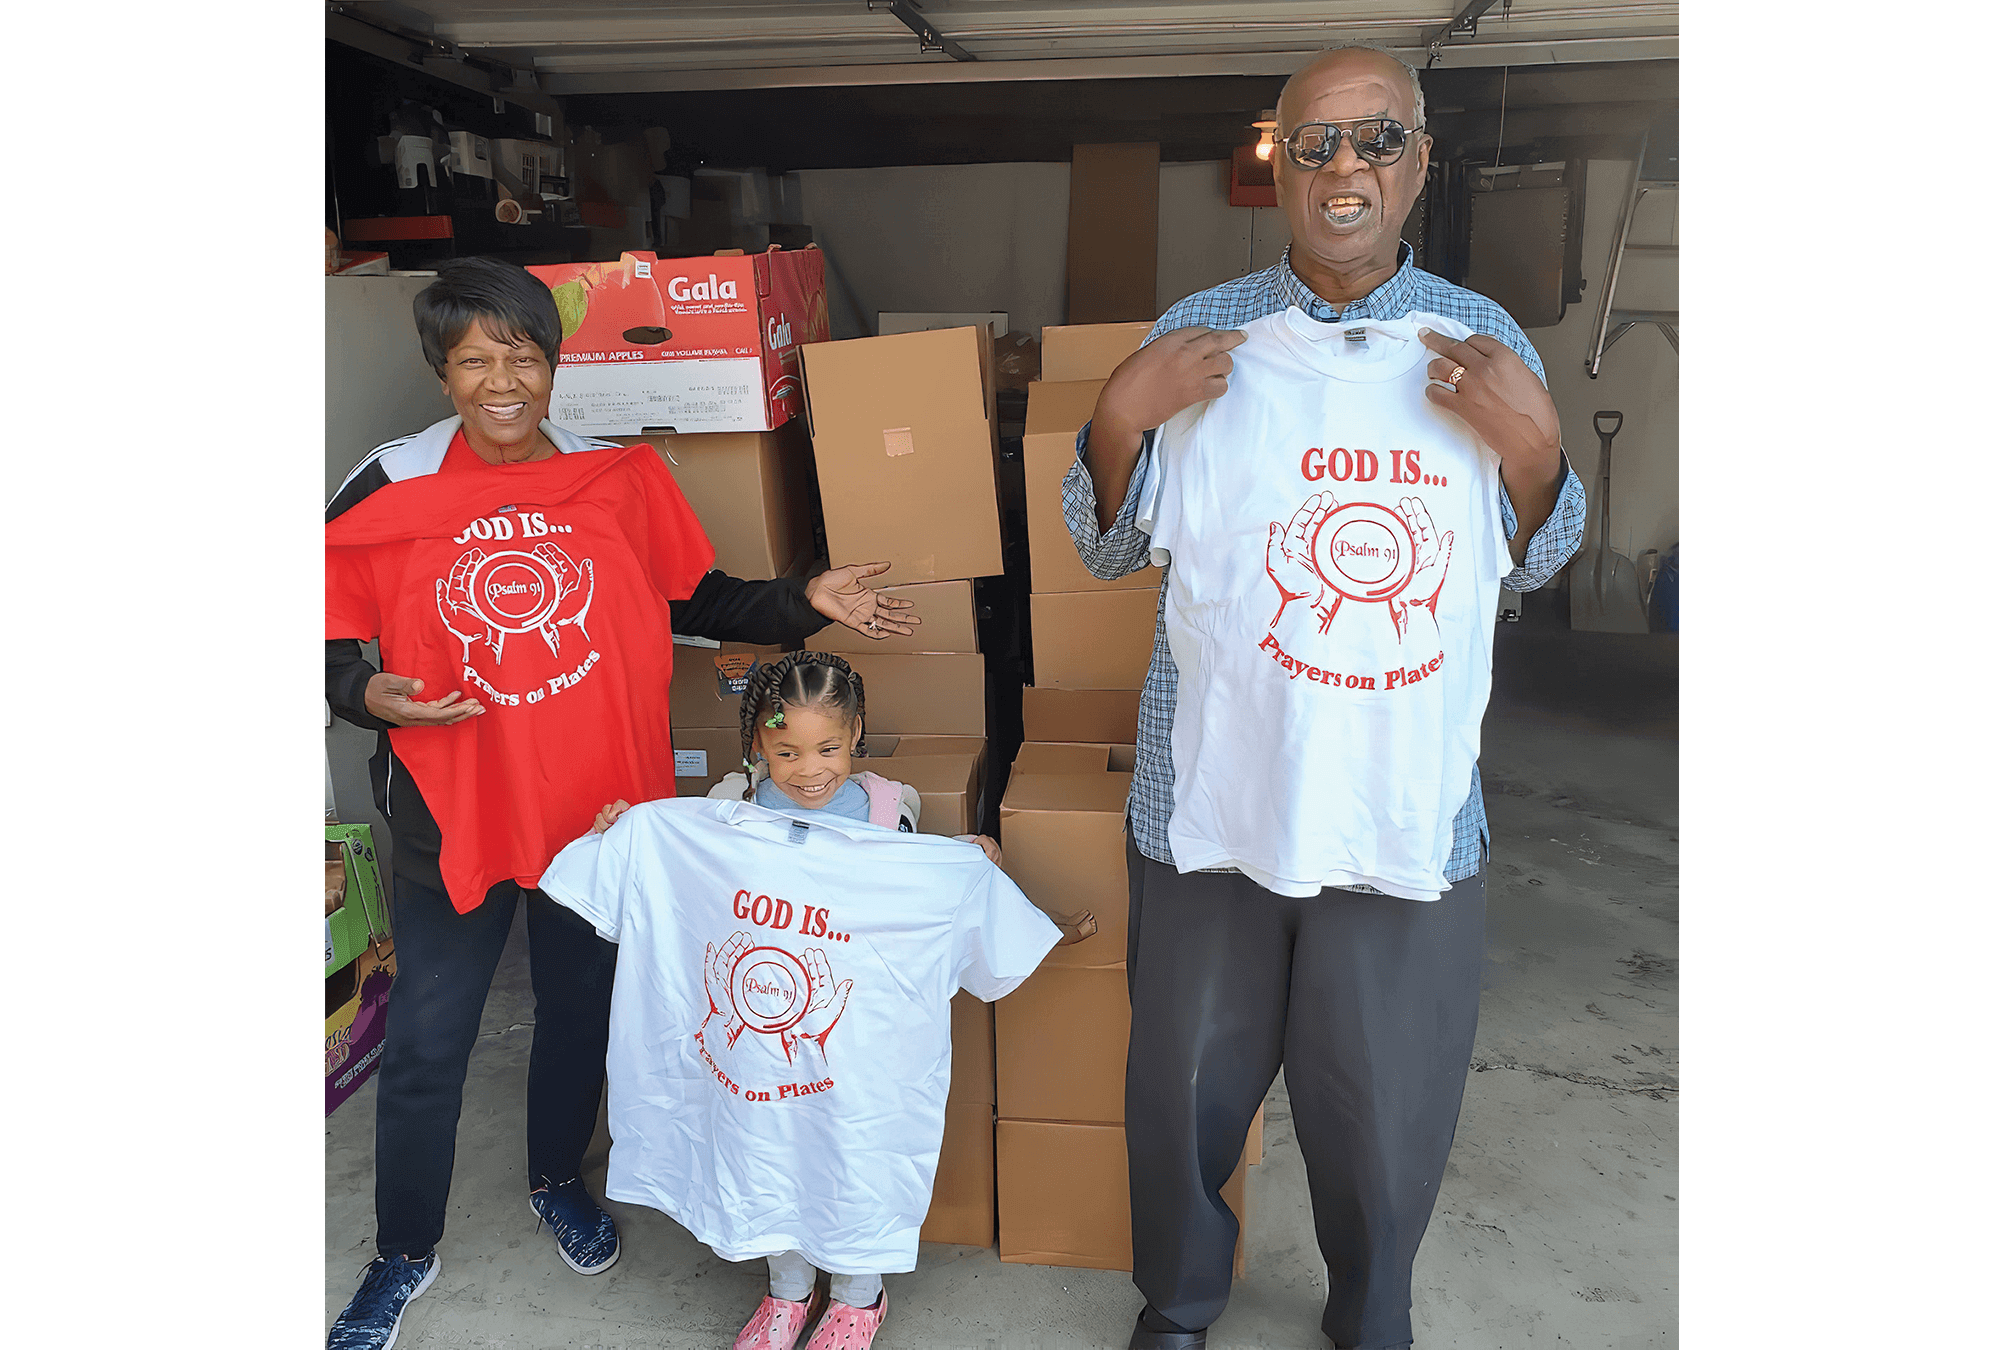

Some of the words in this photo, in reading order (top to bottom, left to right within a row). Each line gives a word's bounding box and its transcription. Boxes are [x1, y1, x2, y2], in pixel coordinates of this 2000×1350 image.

[668, 274, 737, 301] Gala
[768, 312, 792, 350] Gala
[560, 352, 605, 363] PREMIUM
[608, 351, 644, 361] APPLES
[1301, 447, 1379, 482] GOD
[1389, 449, 1447, 487] IS...
[518, 512, 573, 538] IS...
[1335, 540, 1379, 561] Psalm
[1384, 548, 1396, 563] 91
[489, 581, 528, 603] Psalm
[529, 583, 541, 597] 91
[1258, 632, 1342, 687] Prayers
[1345, 675, 1376, 690] on
[464, 665, 520, 706] Prayers
[526, 687, 546, 704] on
[547, 650, 601, 695] Plates
[733, 889, 793, 930] GOD
[798, 904, 850, 943] IS...
[746, 978, 780, 997] Psalm
[694, 1031, 740, 1096] Prayers
[745, 1090, 771, 1102] on
[777, 1077, 835, 1101] Plates
